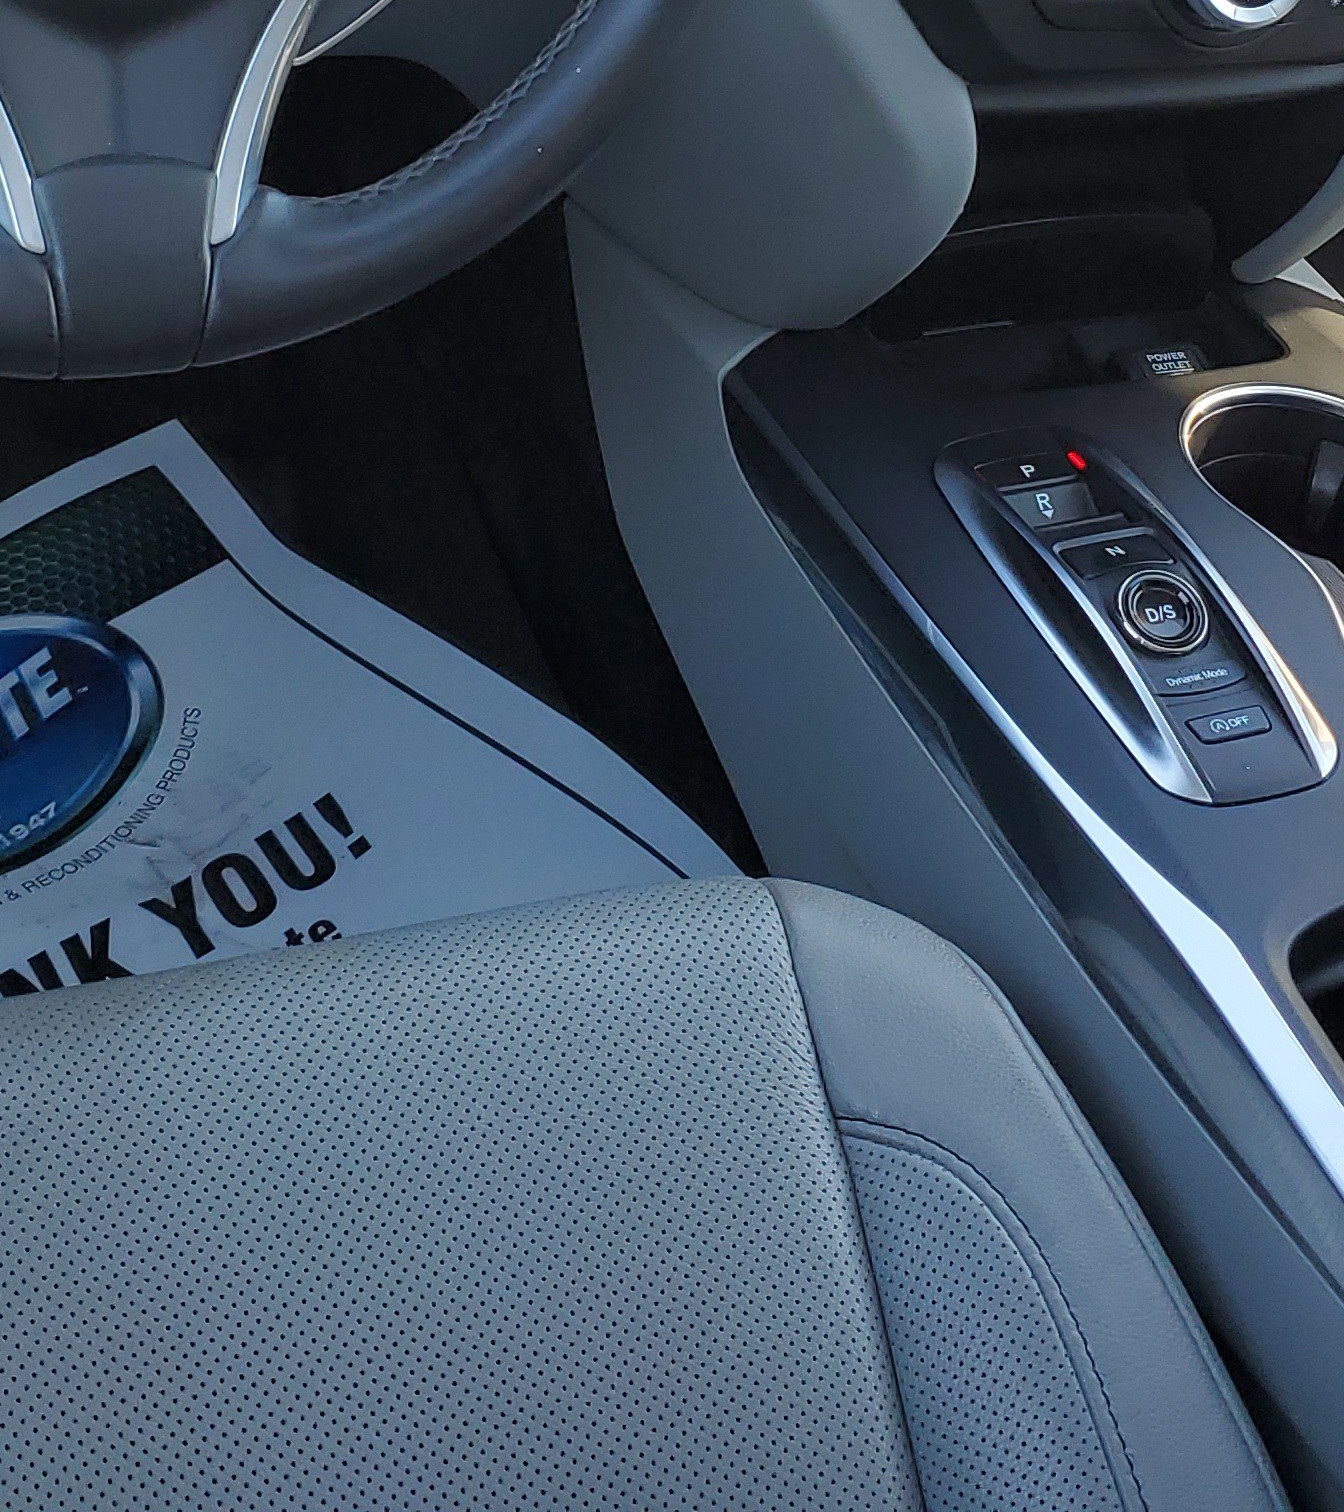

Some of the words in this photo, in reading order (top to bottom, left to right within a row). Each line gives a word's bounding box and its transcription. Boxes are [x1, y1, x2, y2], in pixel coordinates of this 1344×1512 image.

[1146, 351, 1187, 363] POWER
[1151, 360, 1192, 371] OUTLET
[1019, 464, 1035, 477] P
[1035, 492, 1053, 510] R
[1104, 545, 1126, 557] N
[1144, 603, 1177, 623] D/S
[1165, 673, 1204, 687] Dynamic
[1201, 668, 1229, 680] Mode
[1227, 715, 1250, 727] OFF
[3, 888, 22, 903] &
[22, 790, 165, 895] RECONDITIONING
[155, 705, 203, 793] PRODUCTS
[137, 791, 373, 960] YOU!
